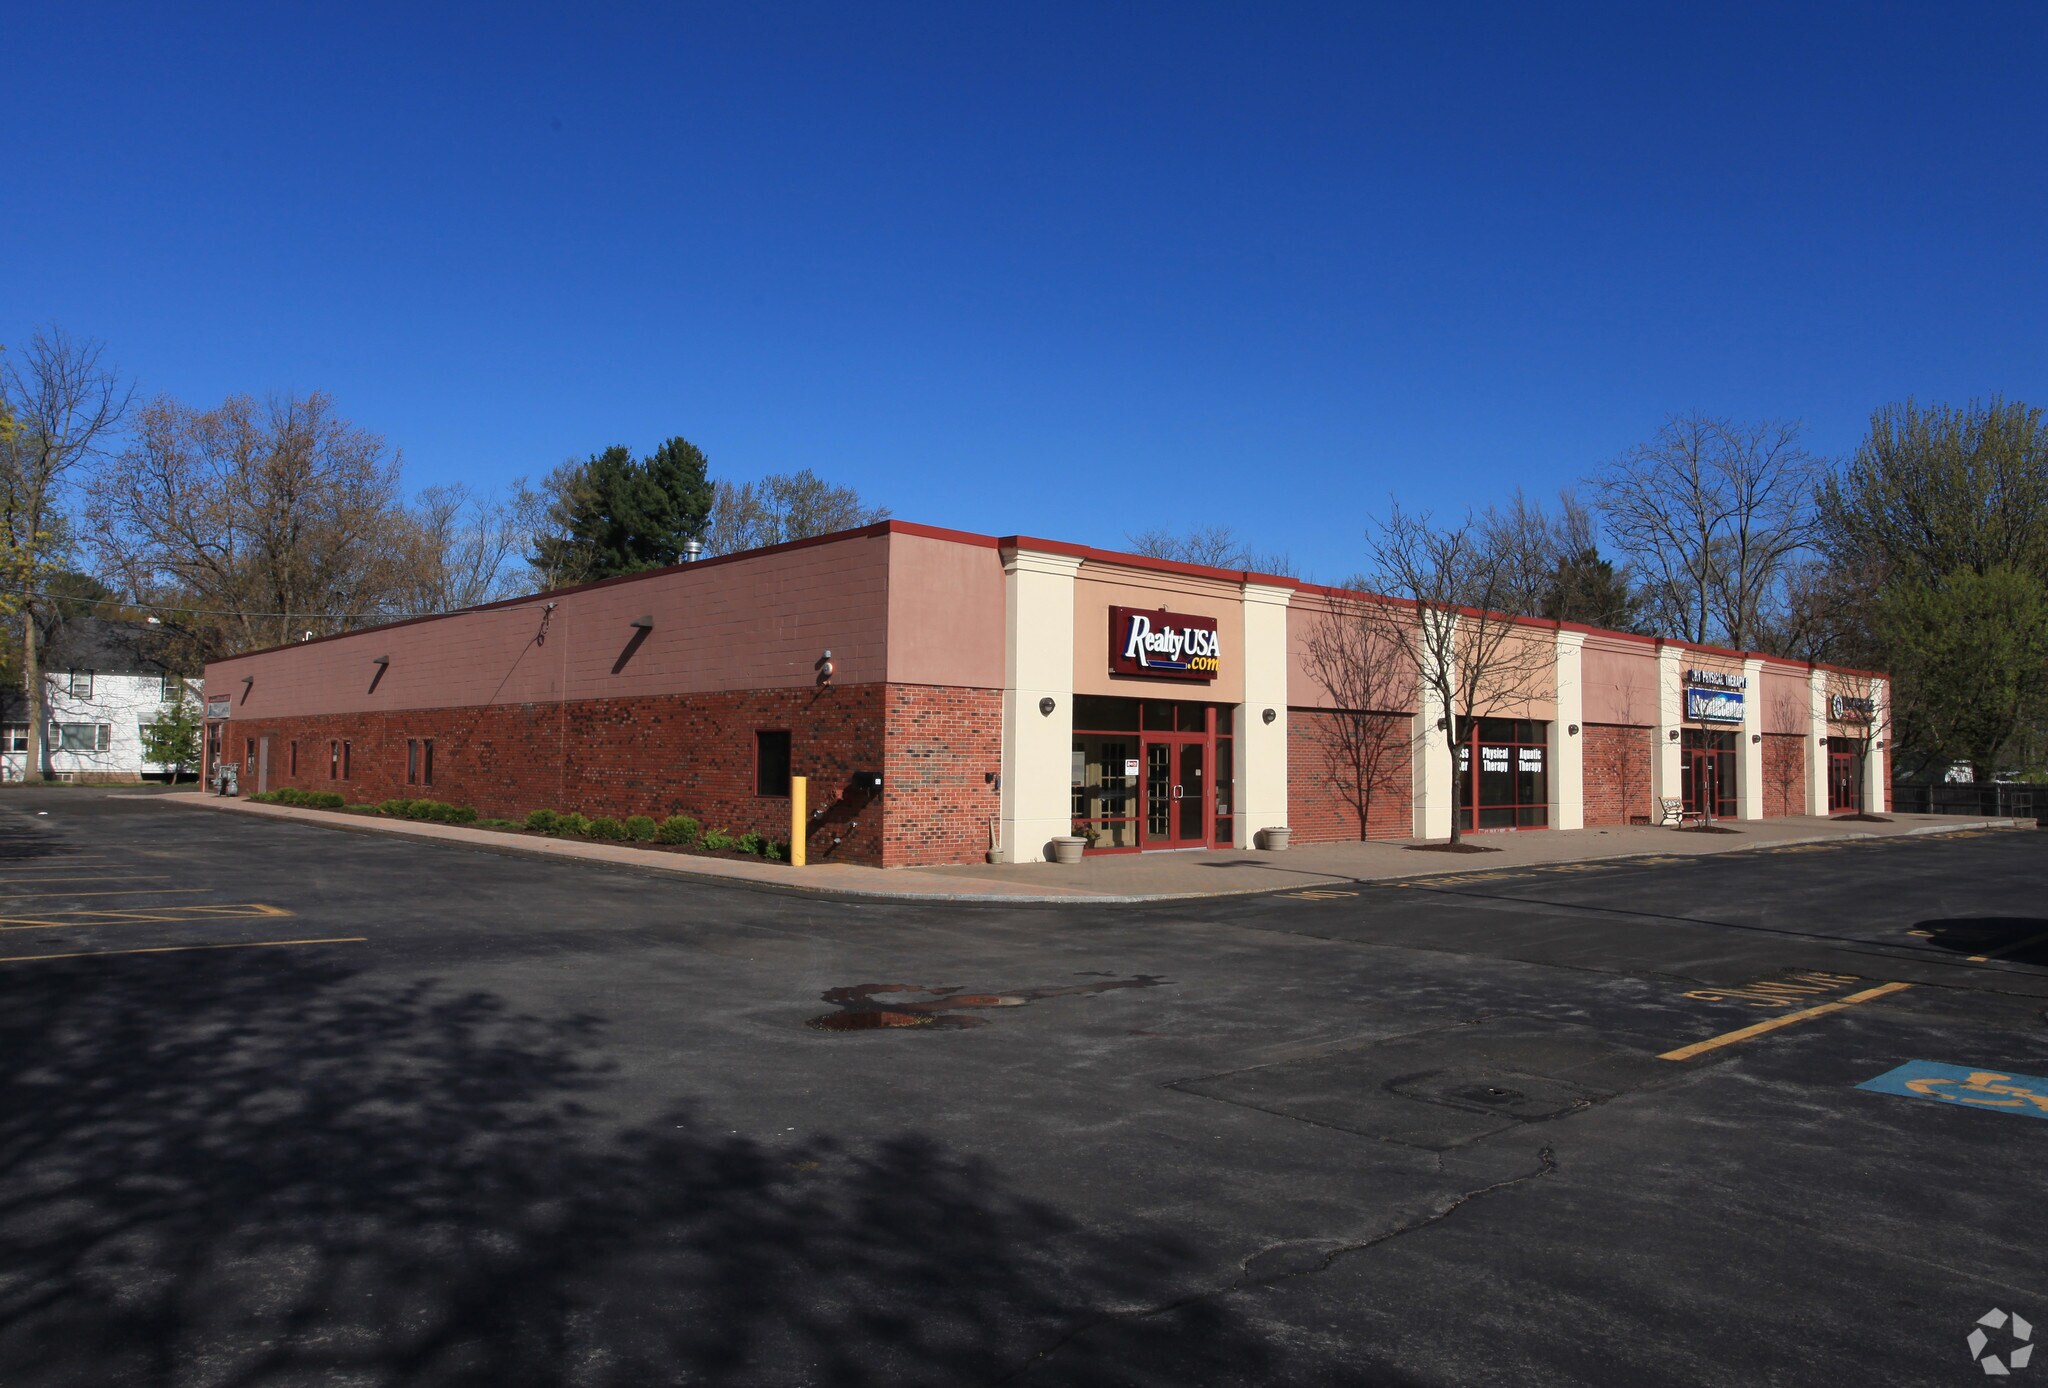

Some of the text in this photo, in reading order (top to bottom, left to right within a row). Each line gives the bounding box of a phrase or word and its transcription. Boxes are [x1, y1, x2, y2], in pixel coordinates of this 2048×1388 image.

[1125, 615, 1221, 667] RealtyUSA
[1187, 657, 1220, 671] .com
[1725, 674, 1745, 688] THERAPY
[1482, 747, 1509, 760] Physical
[1519, 748, 1542, 760] Aquatic
[1483, 760, 1508, 772] Therapy
[1519, 760, 1542, 772] Therapy
